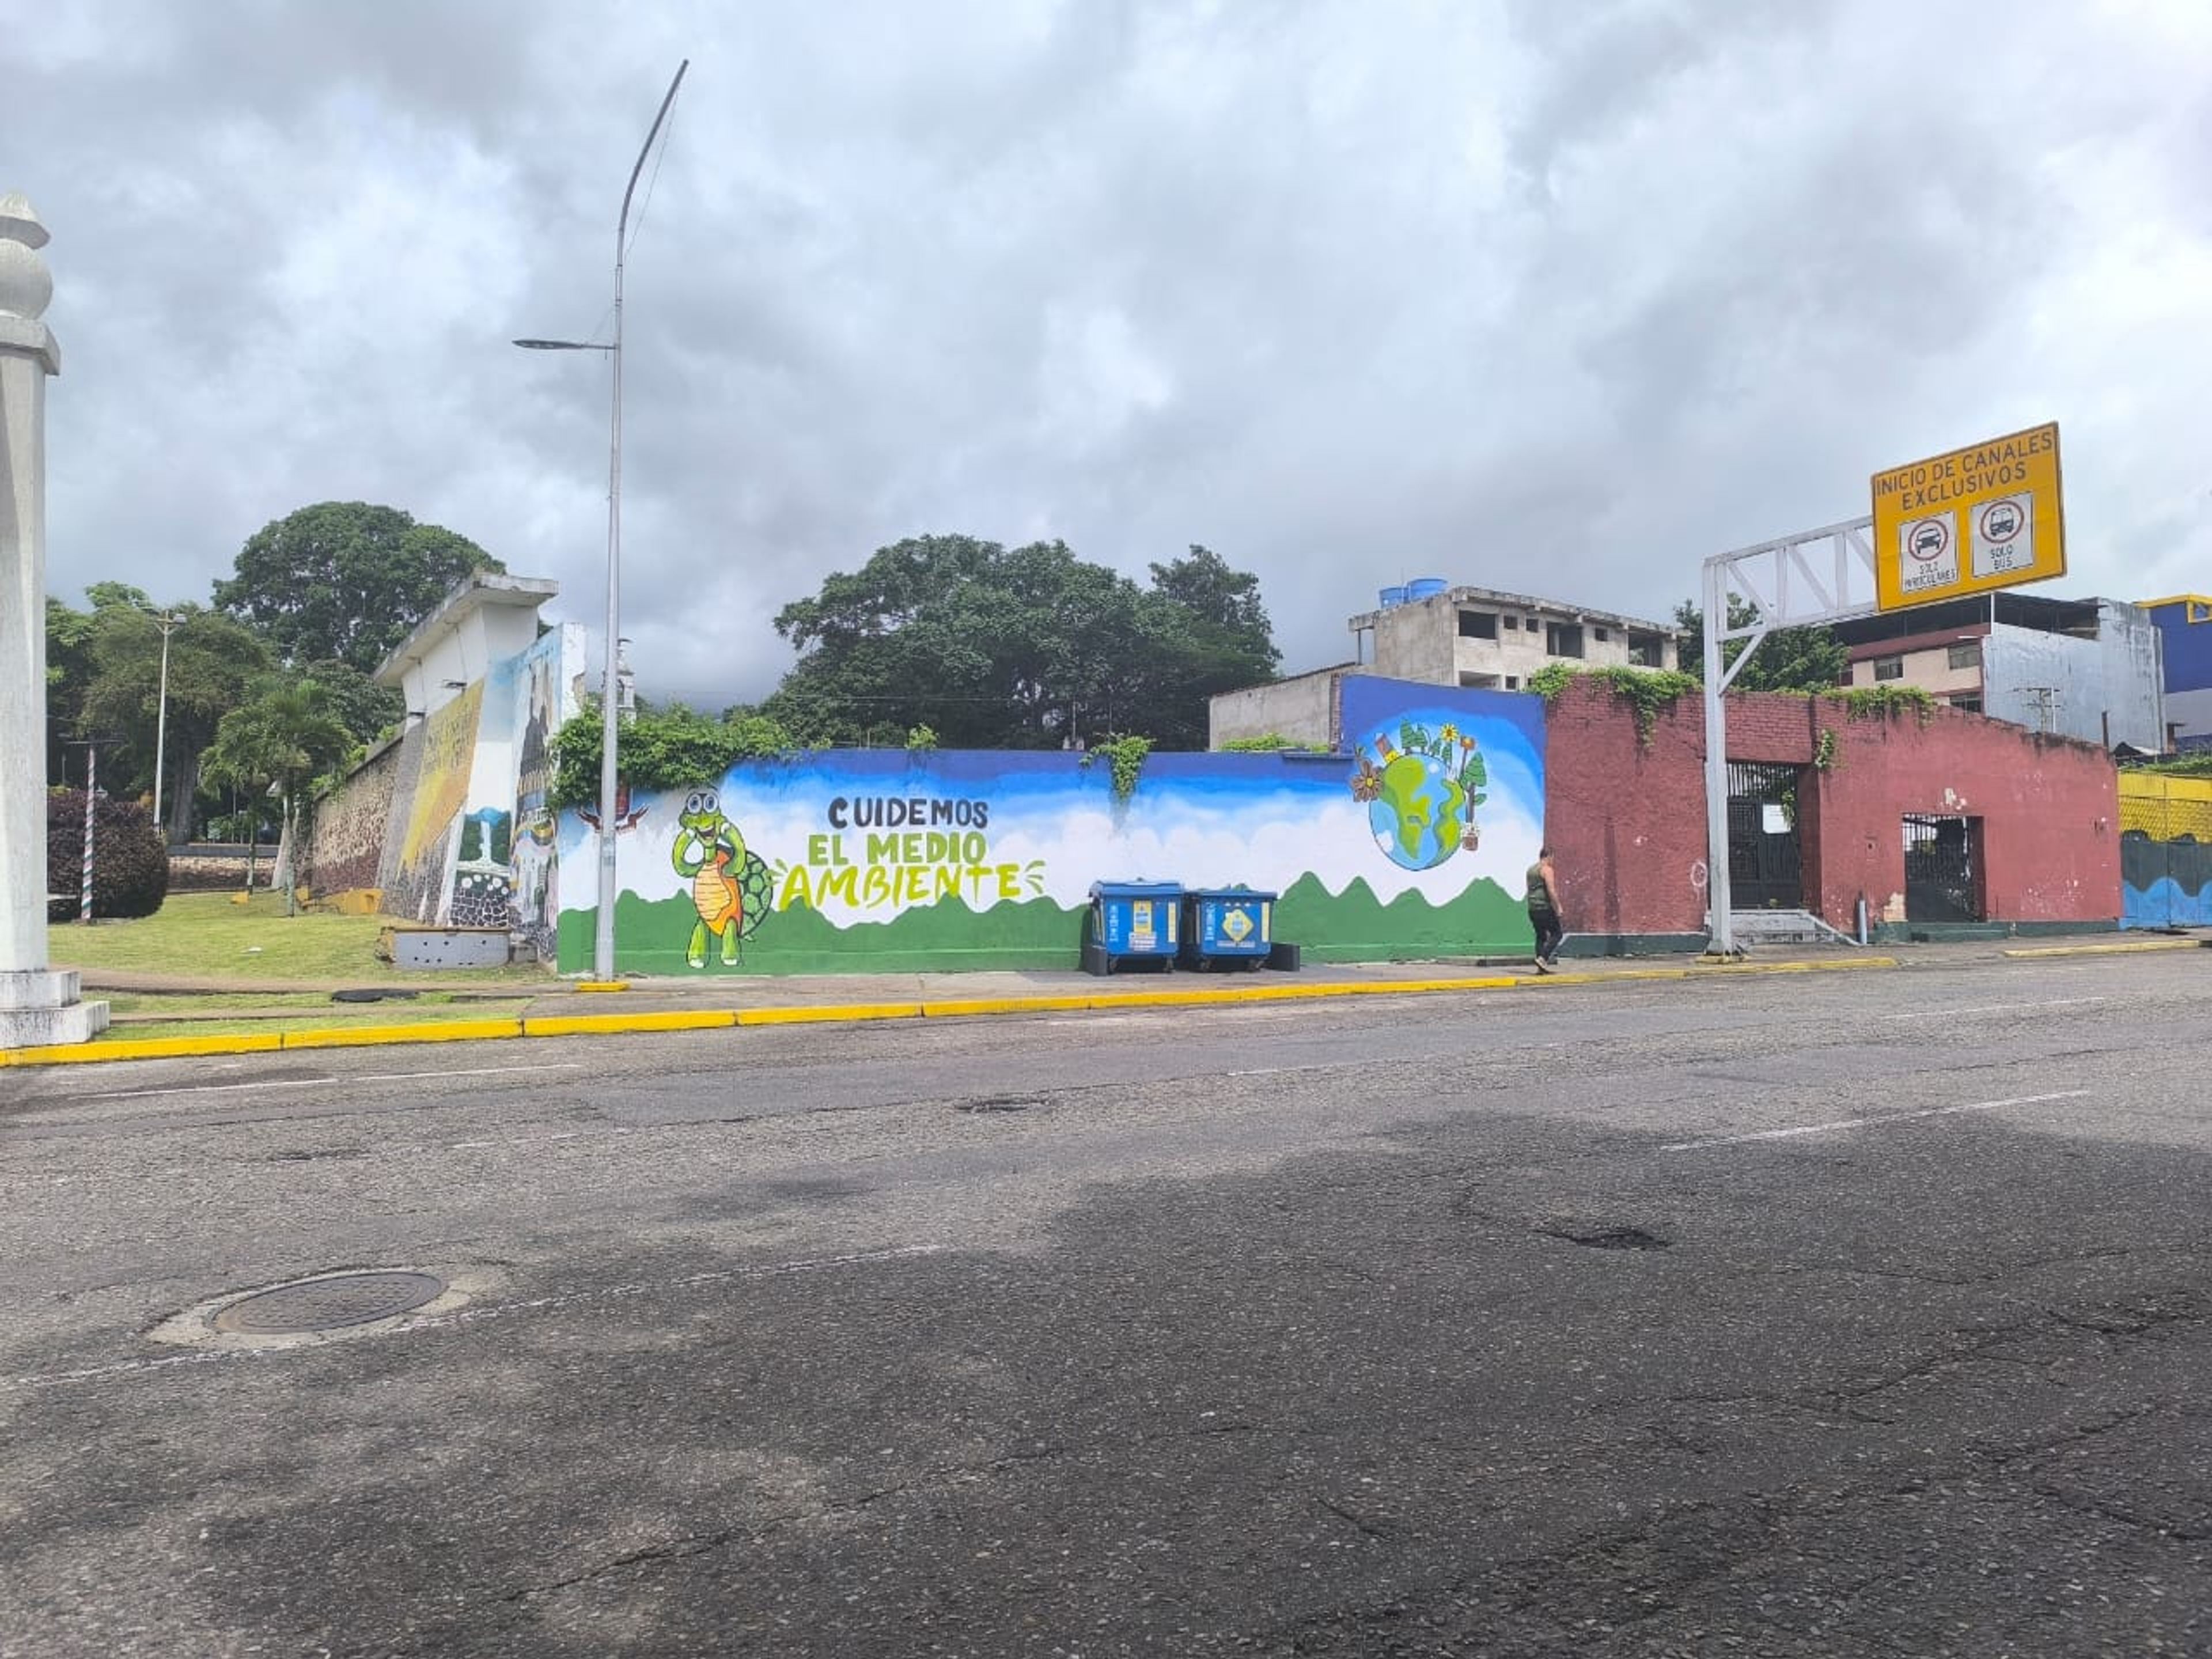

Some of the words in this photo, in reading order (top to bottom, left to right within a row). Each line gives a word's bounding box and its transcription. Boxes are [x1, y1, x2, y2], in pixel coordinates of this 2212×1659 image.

[1877, 468, 1926, 496] INICIO
[1933, 460, 1955, 482] DE
[1963, 433, 2052, 471] CANALES
[1903, 461, 2027, 510] EXCLUSIVOS
[828, 797, 988, 828] CUIDEMOS
[808, 834, 849, 865] EL
[868, 832, 986, 864] MEDIO
[779, 864, 1020, 911] AMBIENTE
